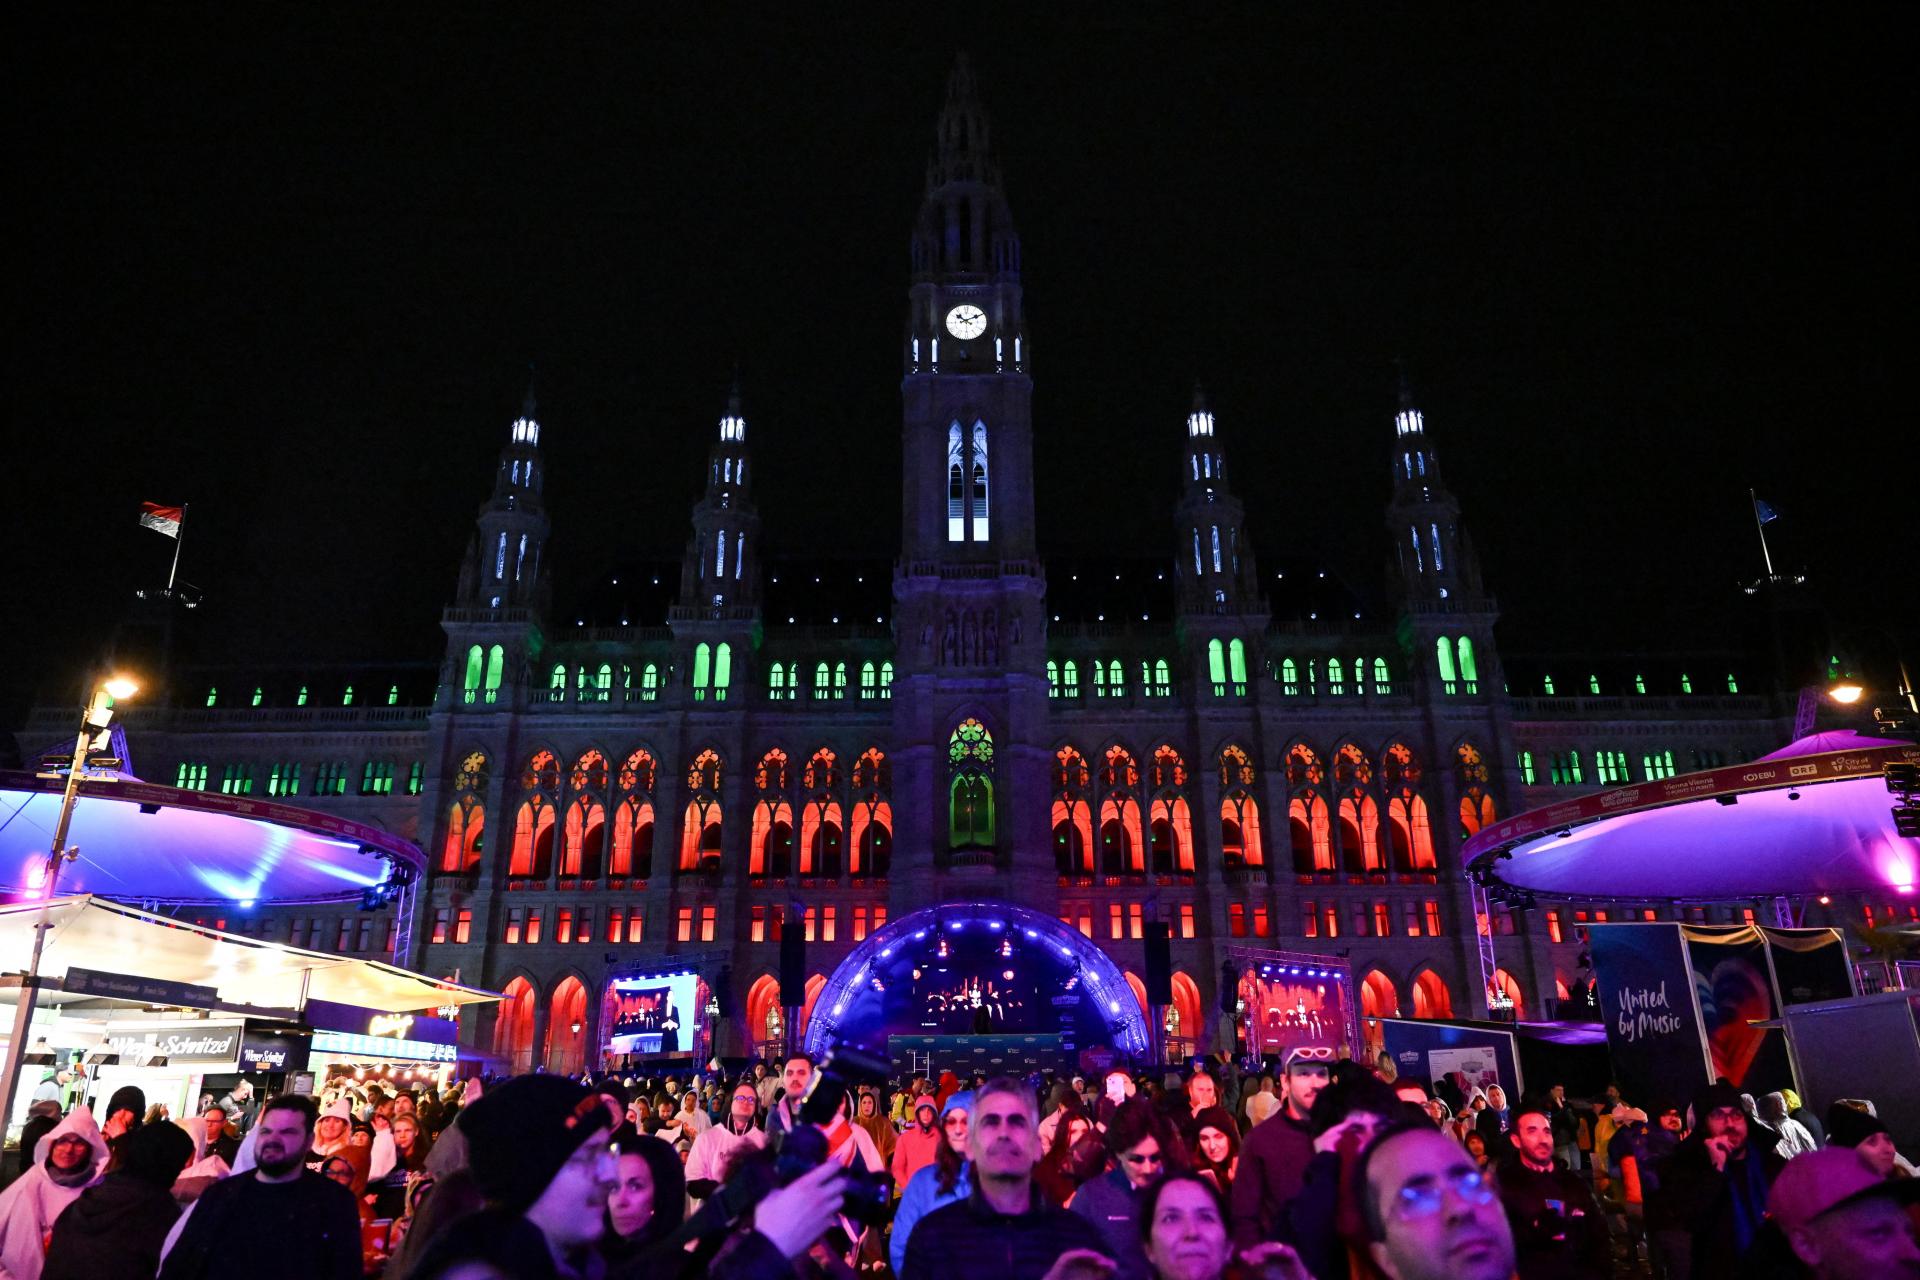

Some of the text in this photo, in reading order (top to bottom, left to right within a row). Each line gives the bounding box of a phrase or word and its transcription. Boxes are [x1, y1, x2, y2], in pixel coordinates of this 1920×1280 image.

[1845, 758, 1859, 766] City
[1758, 770, 1776, 779] EBU
[1792, 766, 1815, 775] ORF
[1664, 777, 1714, 791] Vienna Vienna
[1618, 980, 1670, 1016] United
[1618, 1011, 1681, 1043] by Music
[164, 1035, 233, 1054] Schnitzel
[244, 1049, 263, 1062] Wiener
